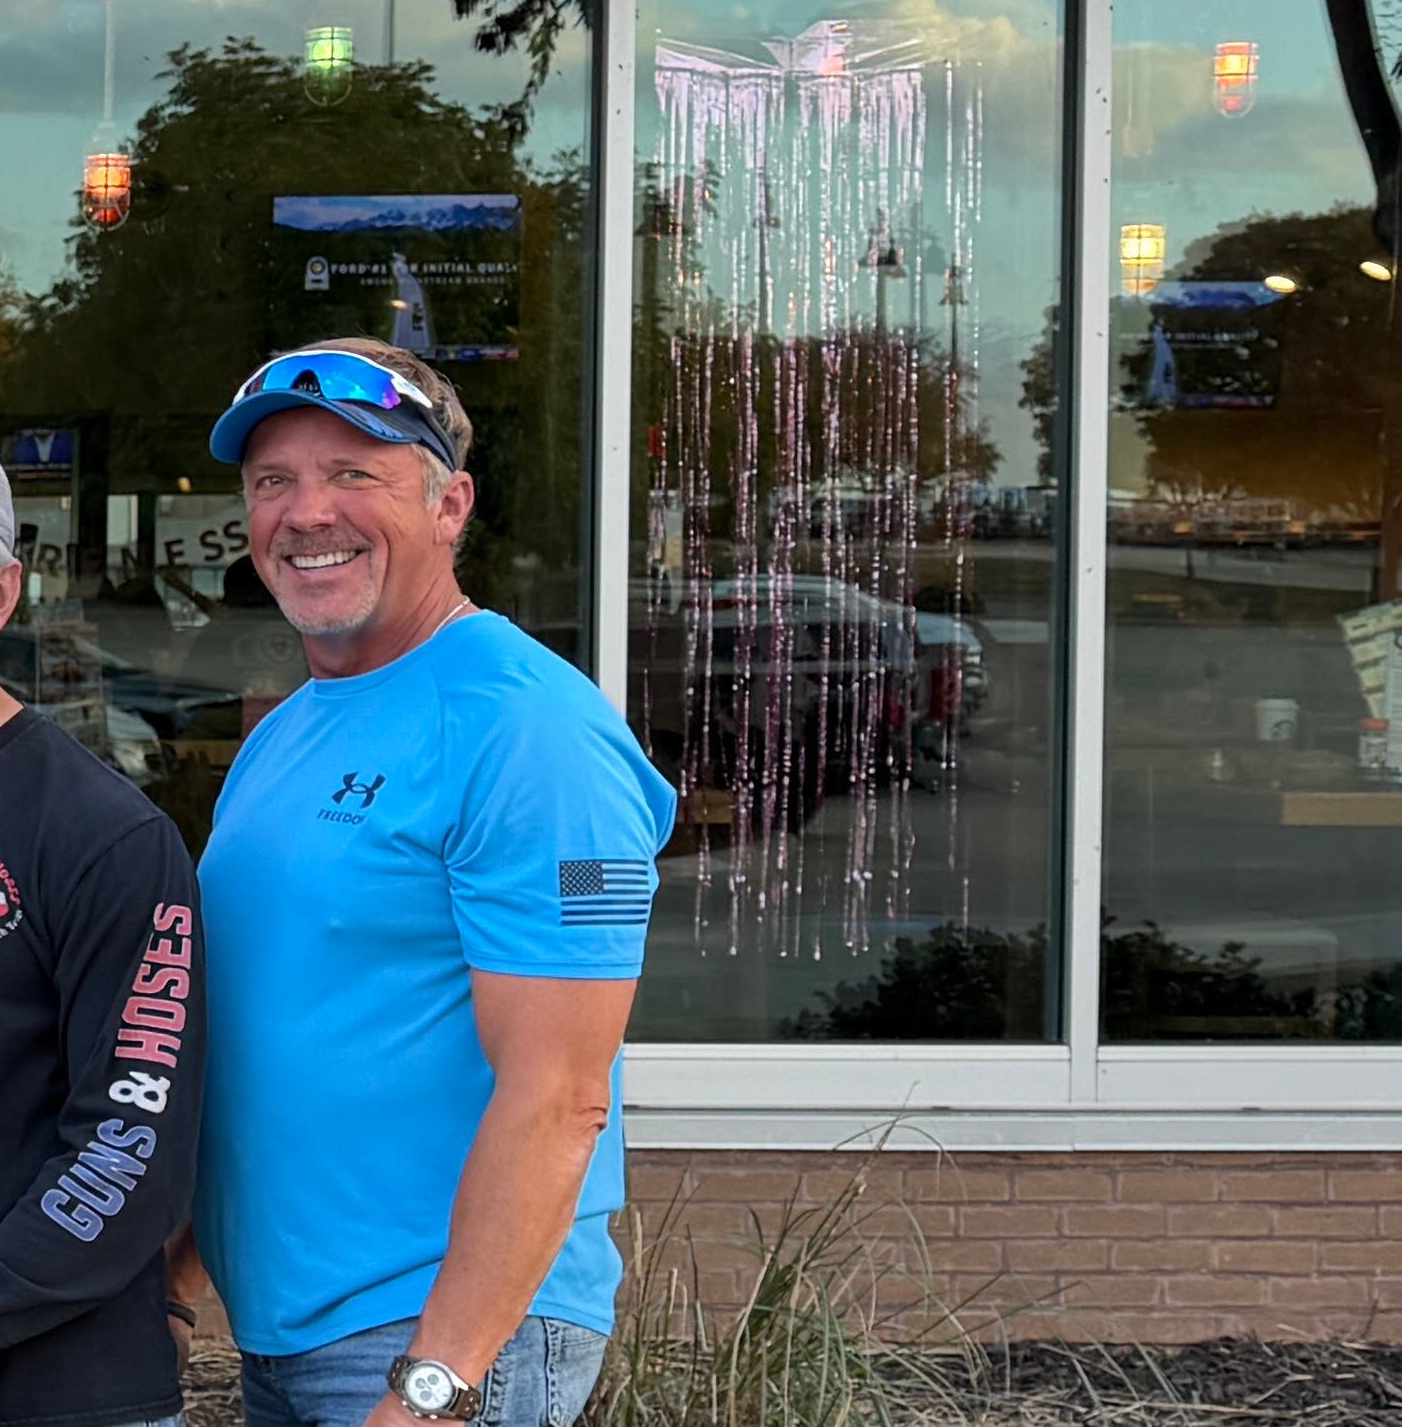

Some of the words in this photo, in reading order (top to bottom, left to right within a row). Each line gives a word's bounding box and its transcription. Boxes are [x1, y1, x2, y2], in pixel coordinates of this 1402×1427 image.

[114, 902, 193, 1069] HOSES
[108, 1070, 171, 1115] &
[40, 1118, 157, 1243] GUNS
